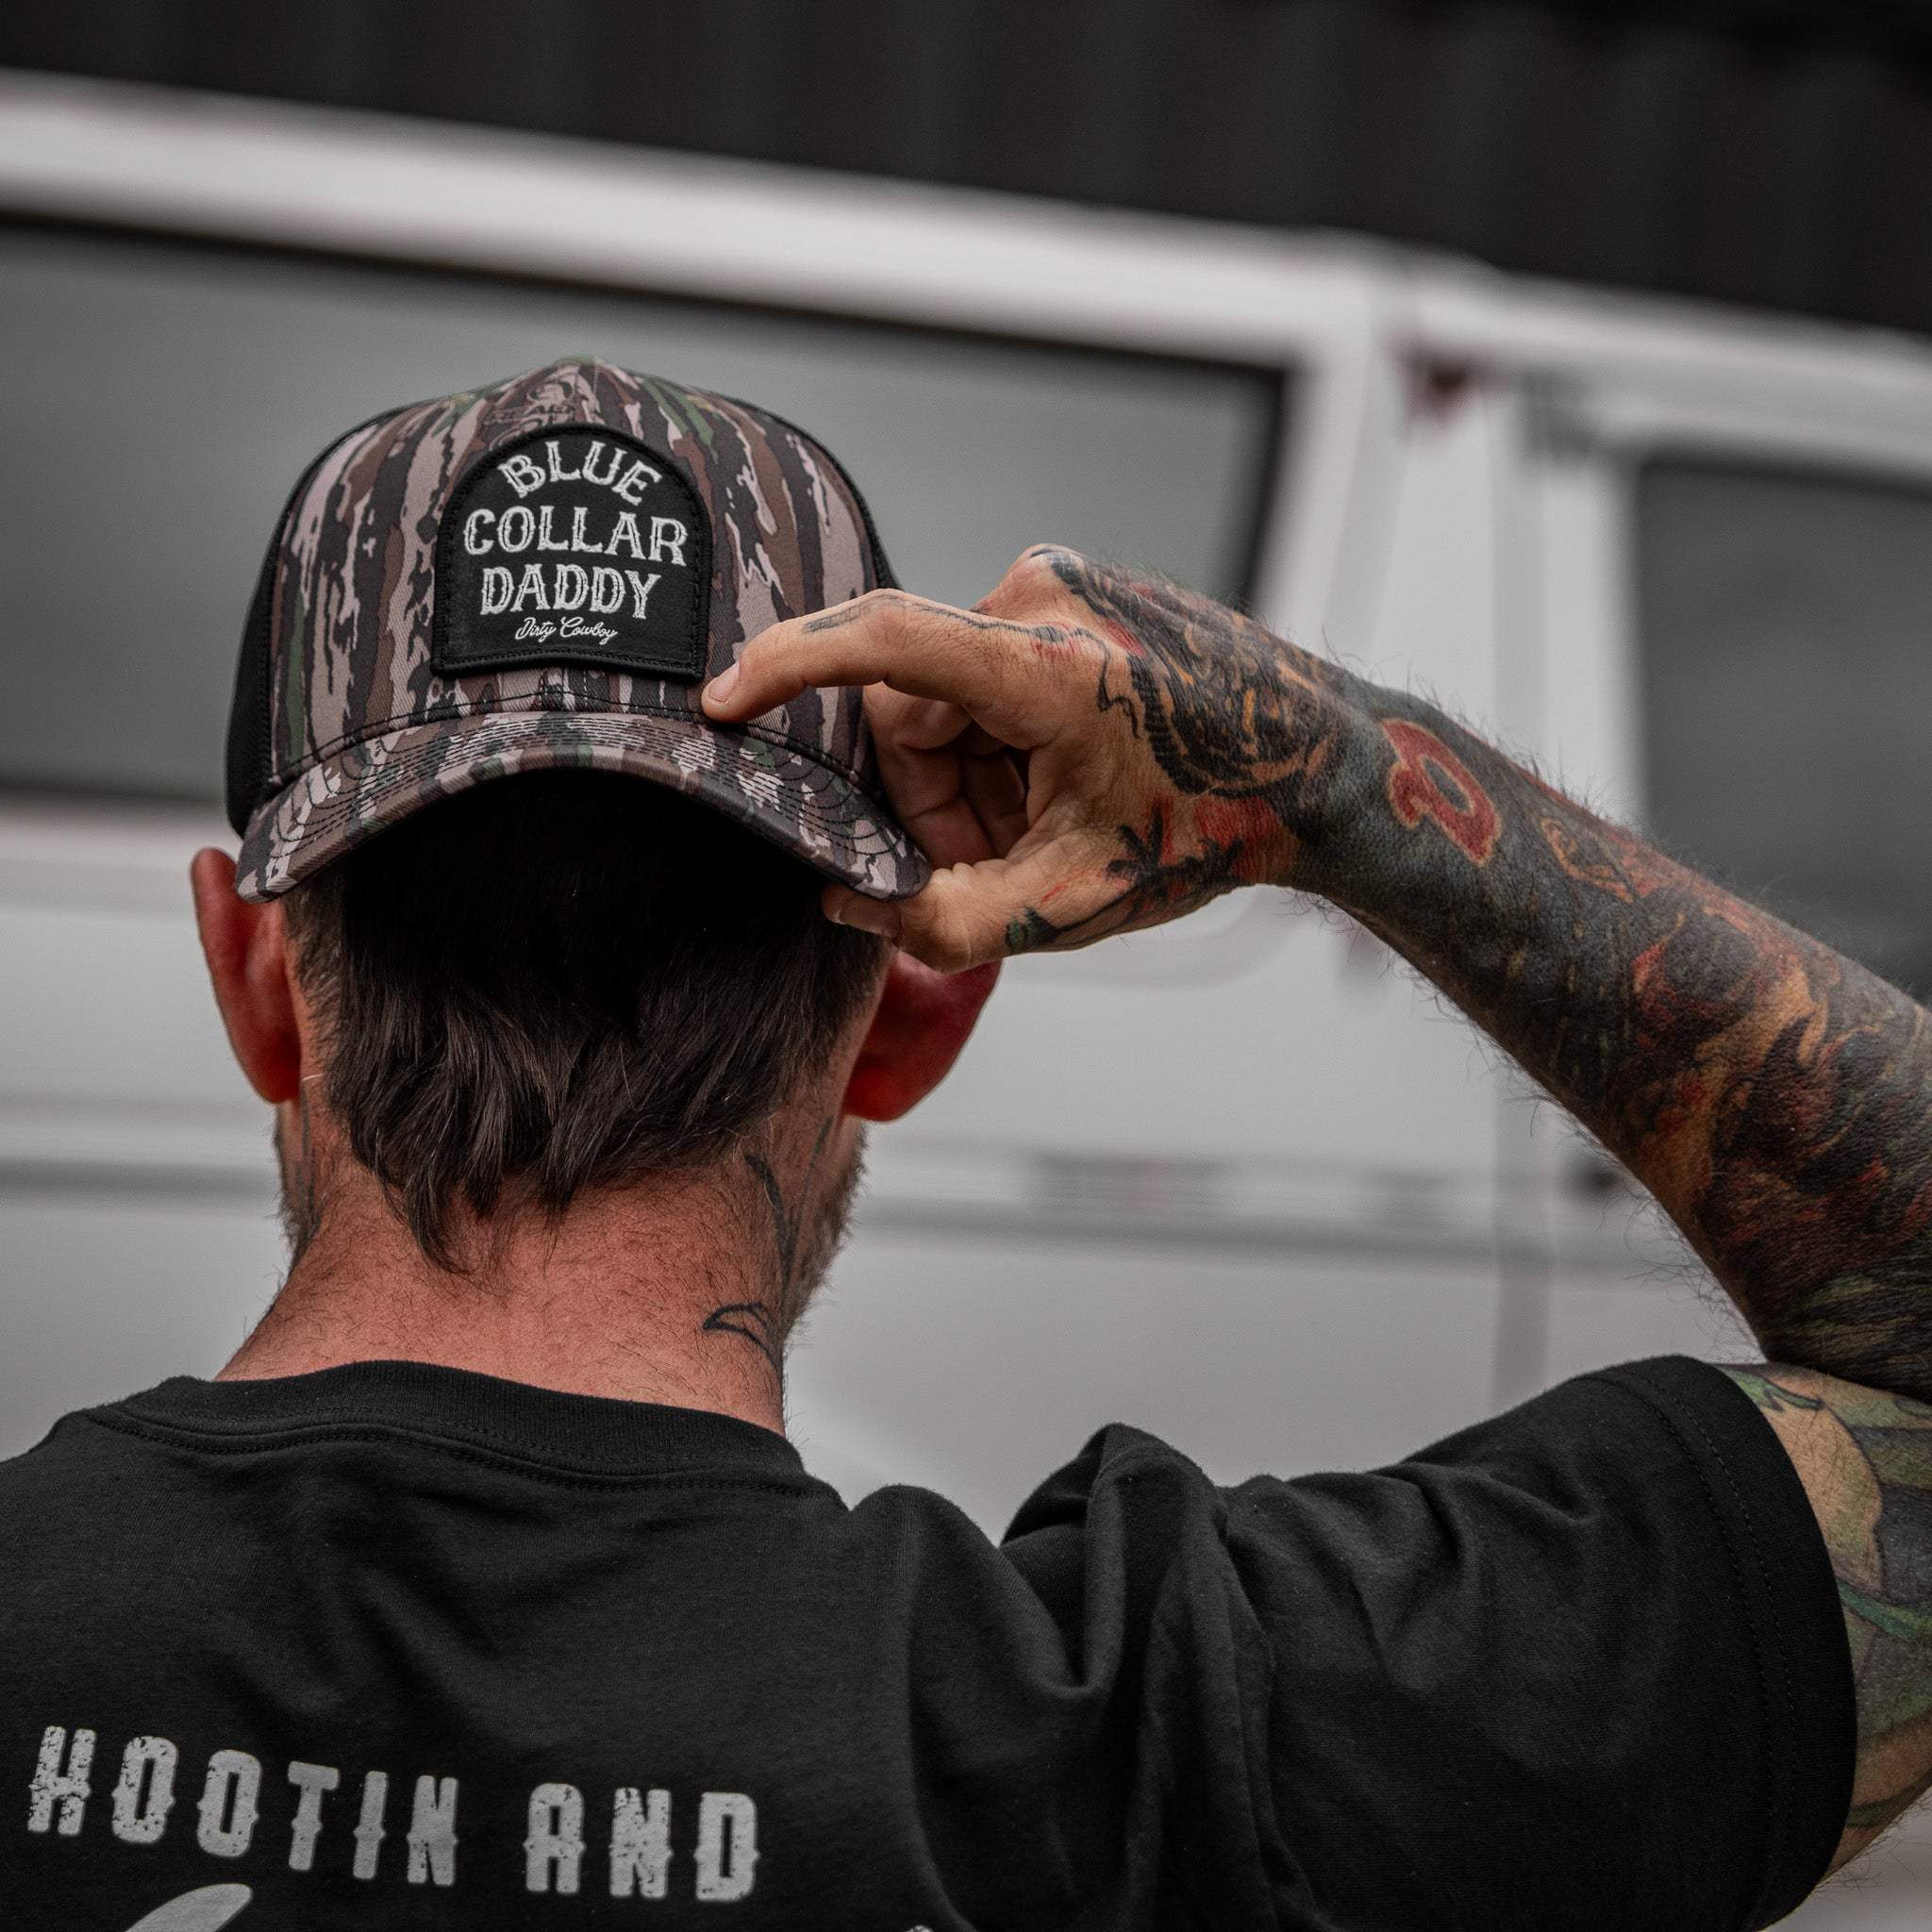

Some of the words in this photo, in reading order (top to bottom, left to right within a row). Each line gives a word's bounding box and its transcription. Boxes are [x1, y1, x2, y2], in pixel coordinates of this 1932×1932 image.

[497, 441, 662, 506] BLUE
[463, 506, 688, 566] COLLAR
[479, 564, 661, 619] DADDY
[515, 616, 557, 642] Dirty
[559, 616, 618, 644] Cowboy
[27, 1725, 459, 1886] HOOTIN
[522, 1782, 759, 1902] AND
